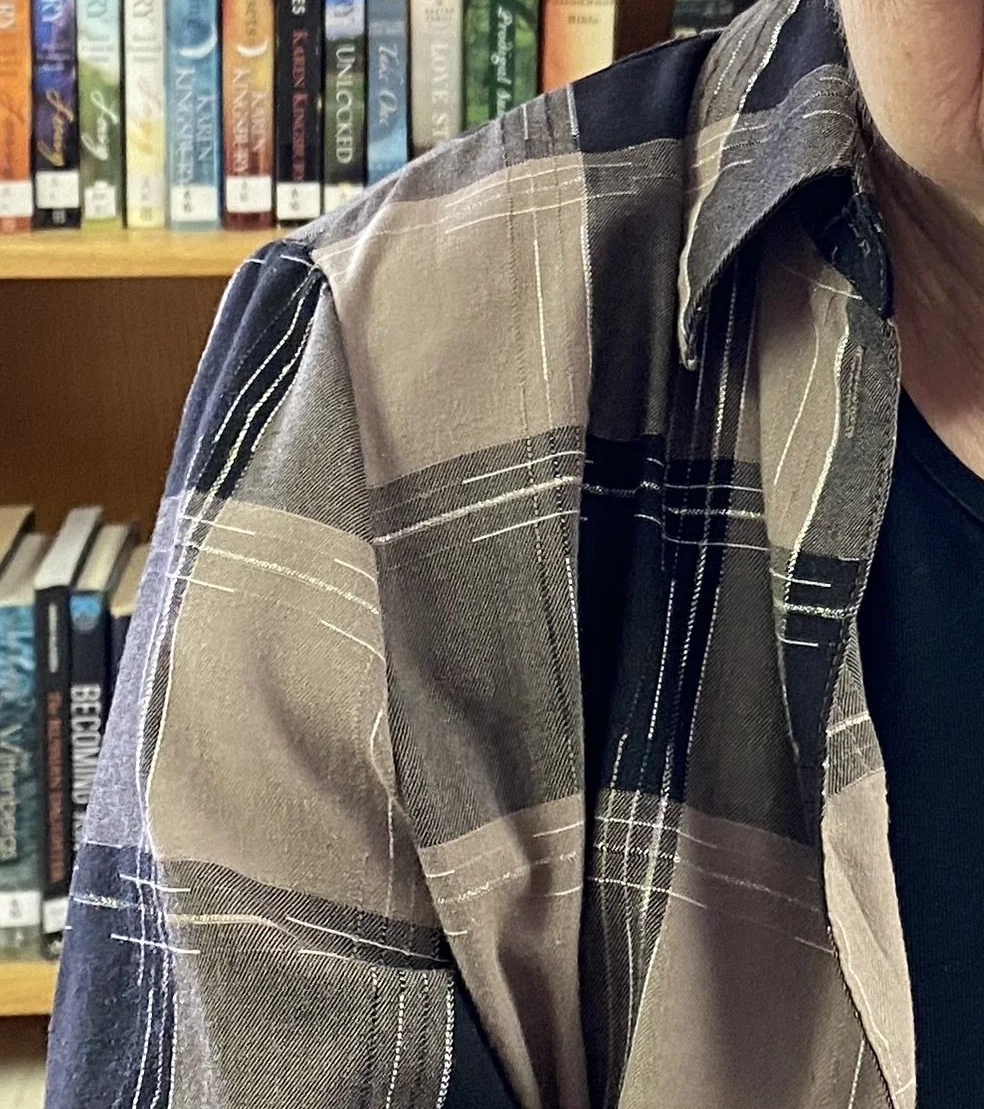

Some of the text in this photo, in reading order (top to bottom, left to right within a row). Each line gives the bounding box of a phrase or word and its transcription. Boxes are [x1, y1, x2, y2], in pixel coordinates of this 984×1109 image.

[292, 29, 308, 88] KAREN
[430, 41, 449, 106] LOVE
[490, 5, 513, 84] Prodigal
[174, 65, 196, 184] KINGSBURY
[195, 93, 215, 162] KAREN
[231, 66, 250, 173] KINGSBURY
[250, 91, 266, 154] KAREN
[292, 93, 308, 181] KINGSBURY
[333, 44, 358, 164] UNLOCKED
[70, 683, 103, 804] BECOMING
